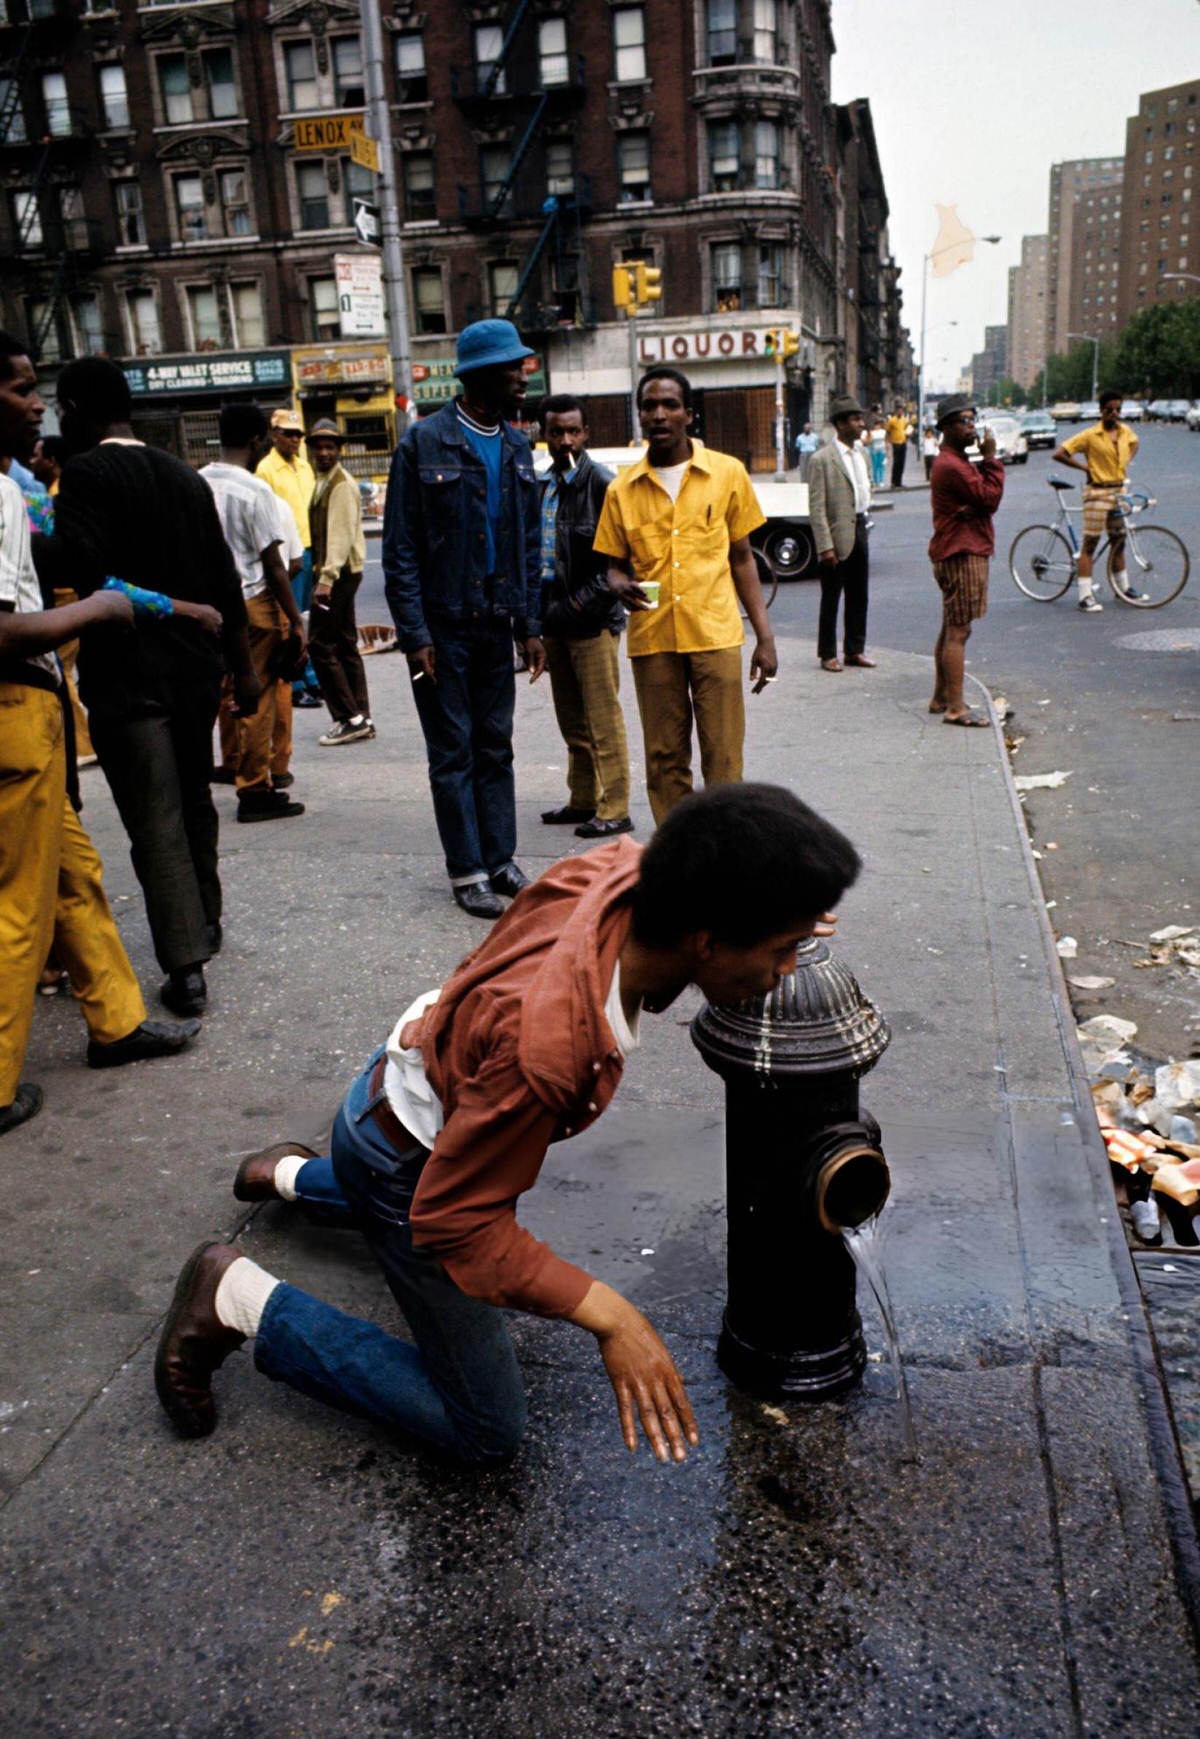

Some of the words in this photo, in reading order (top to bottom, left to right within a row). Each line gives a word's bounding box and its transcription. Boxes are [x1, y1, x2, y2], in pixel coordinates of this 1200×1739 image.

[297, 121, 345, 146] LENOX
[179, 363, 208, 378] VALET
[208, 360, 252, 376] SERVICE
